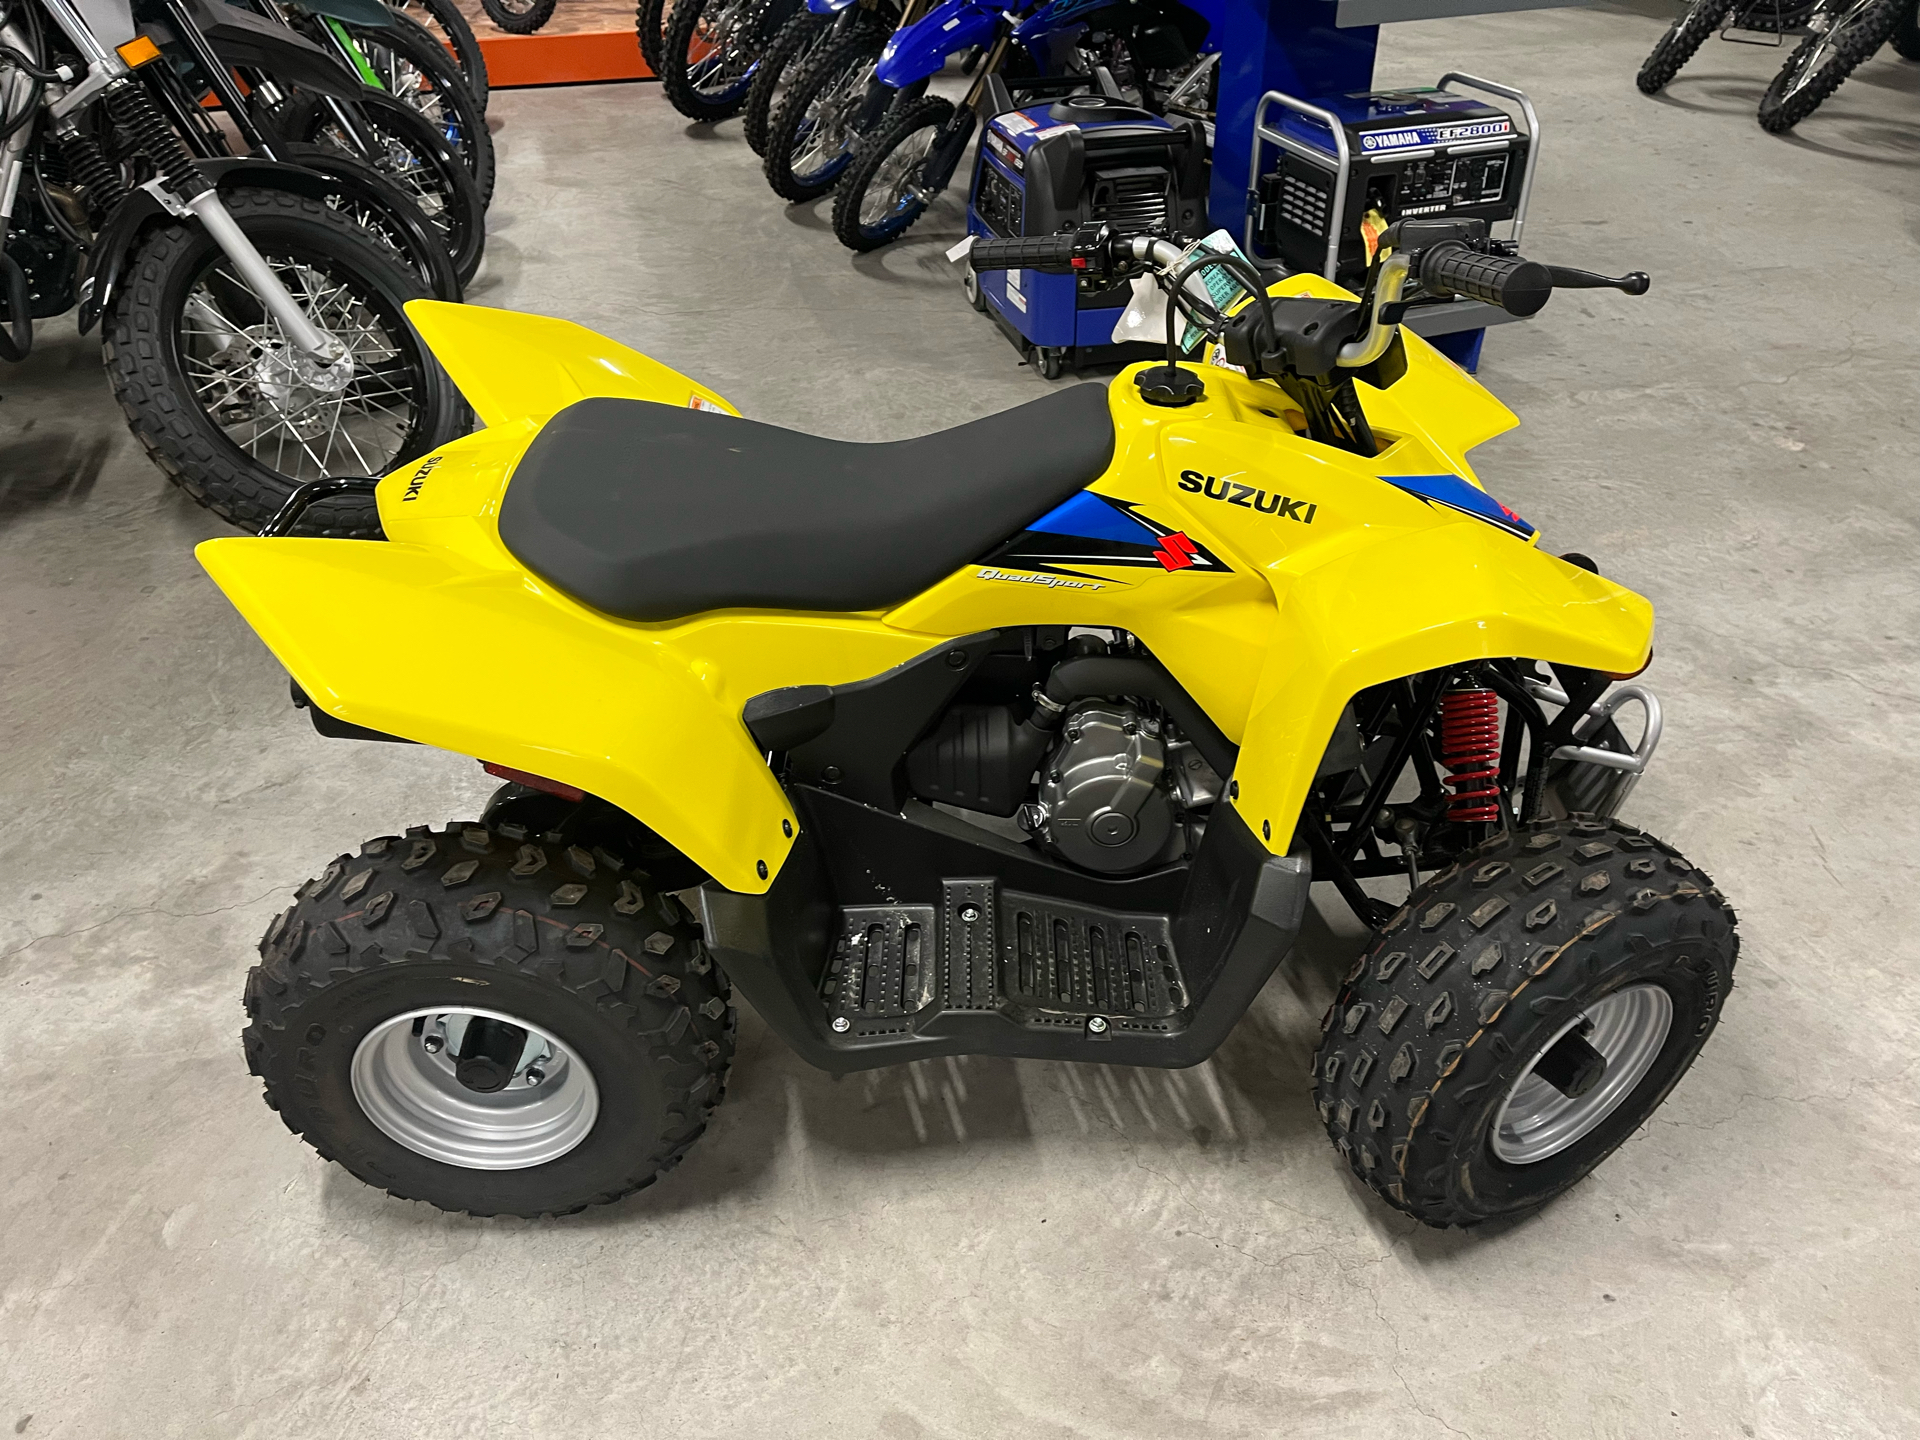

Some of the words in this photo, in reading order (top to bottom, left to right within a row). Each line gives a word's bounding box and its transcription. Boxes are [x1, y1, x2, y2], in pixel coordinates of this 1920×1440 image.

[1374, 131, 1421, 148] YAMAHA
[1437, 121, 1510, 140] EF2800i
[1401, 204, 1446, 216] INVERTER
[402, 456, 443, 501] SUZUKI
[1177, 469, 1318, 525] SUZUKI
[976, 567, 1107, 591] QuadSport
